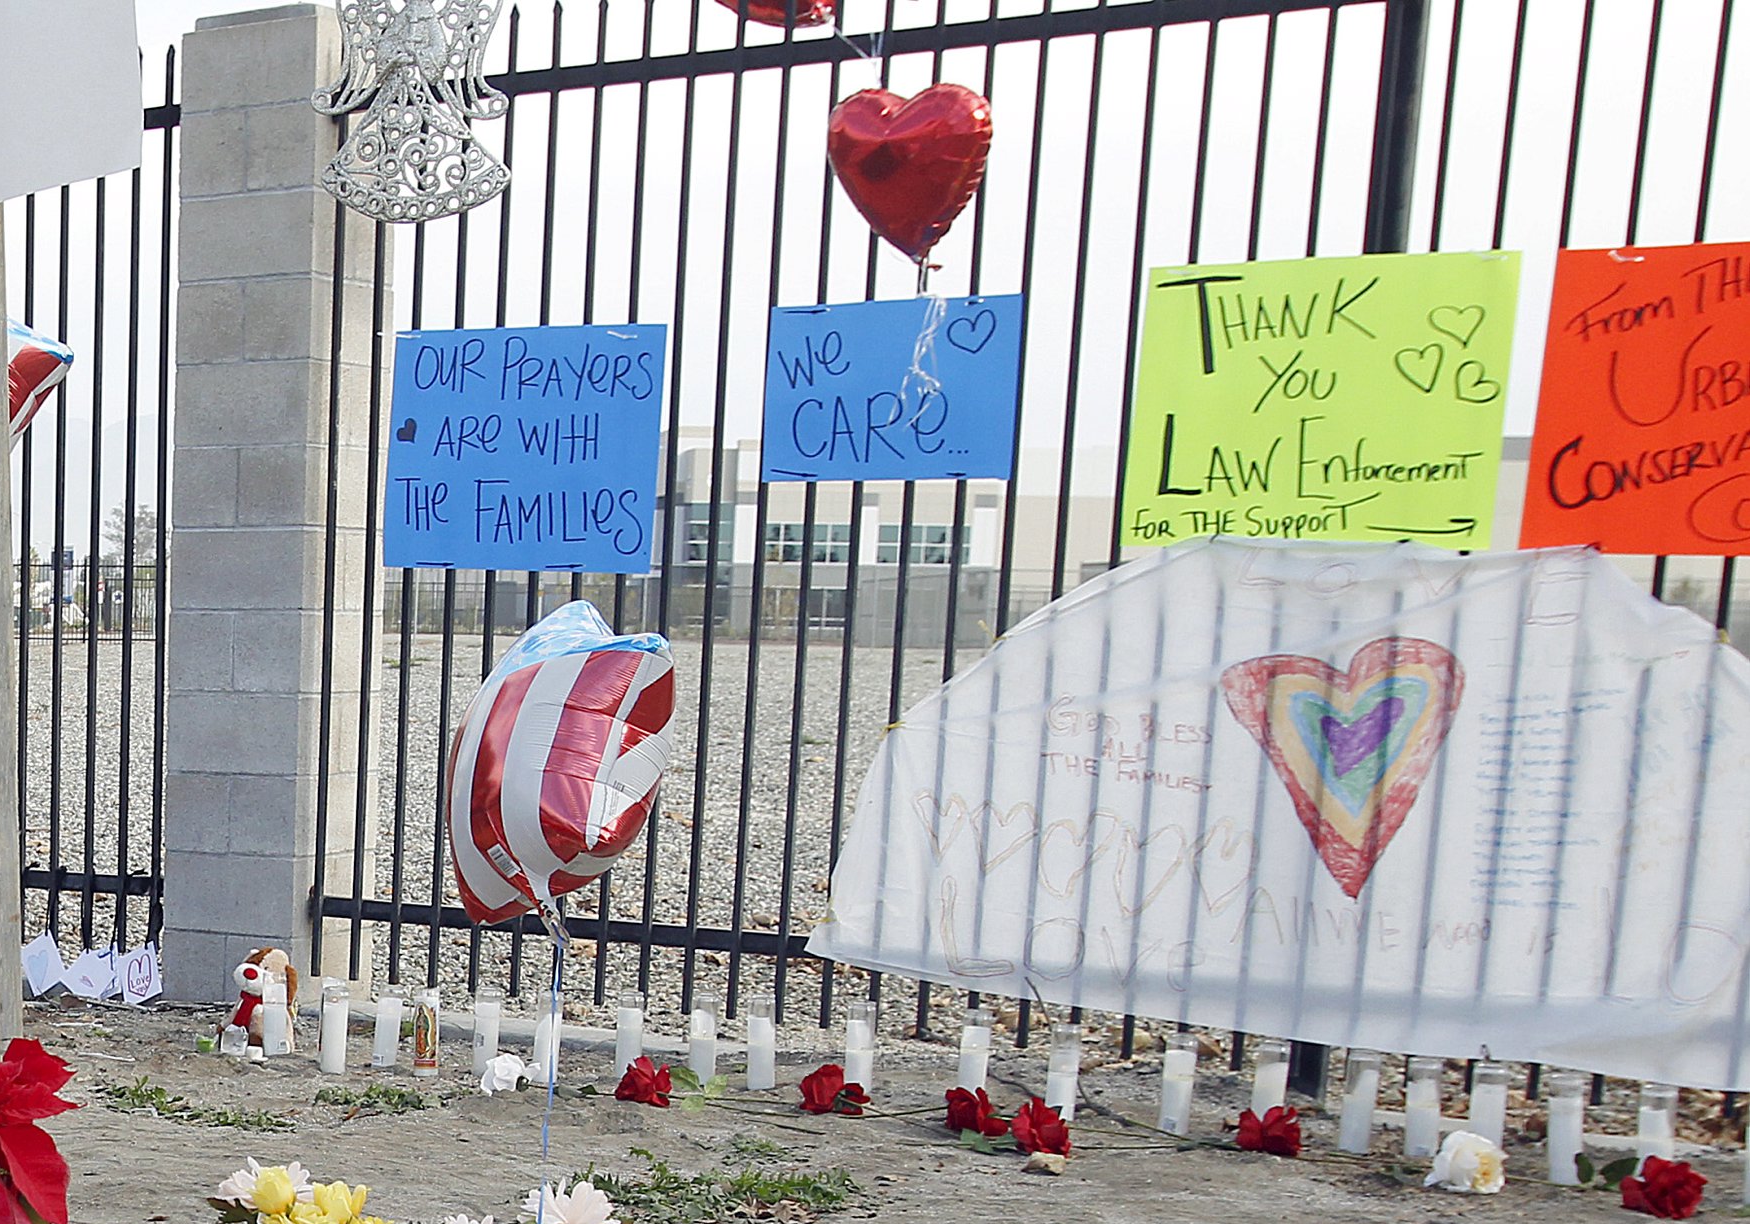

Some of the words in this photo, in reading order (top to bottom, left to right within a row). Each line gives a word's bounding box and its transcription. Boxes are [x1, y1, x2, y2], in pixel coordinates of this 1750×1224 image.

[1155, 275, 1382, 375] THANK
[1563, 281, 1676, 343] From
[1681, 256, 1750, 314] TH
[414, 338, 487, 394] OUR
[1253, 350, 1338, 413] YOU
[1609, 325, 1750, 428] URB
[516, 412, 600, 465] WITH
[1157, 413, 1282, 498] LAW
[1180, 509, 1239, 544] THE
[1040, 751, 1100, 779] THE
